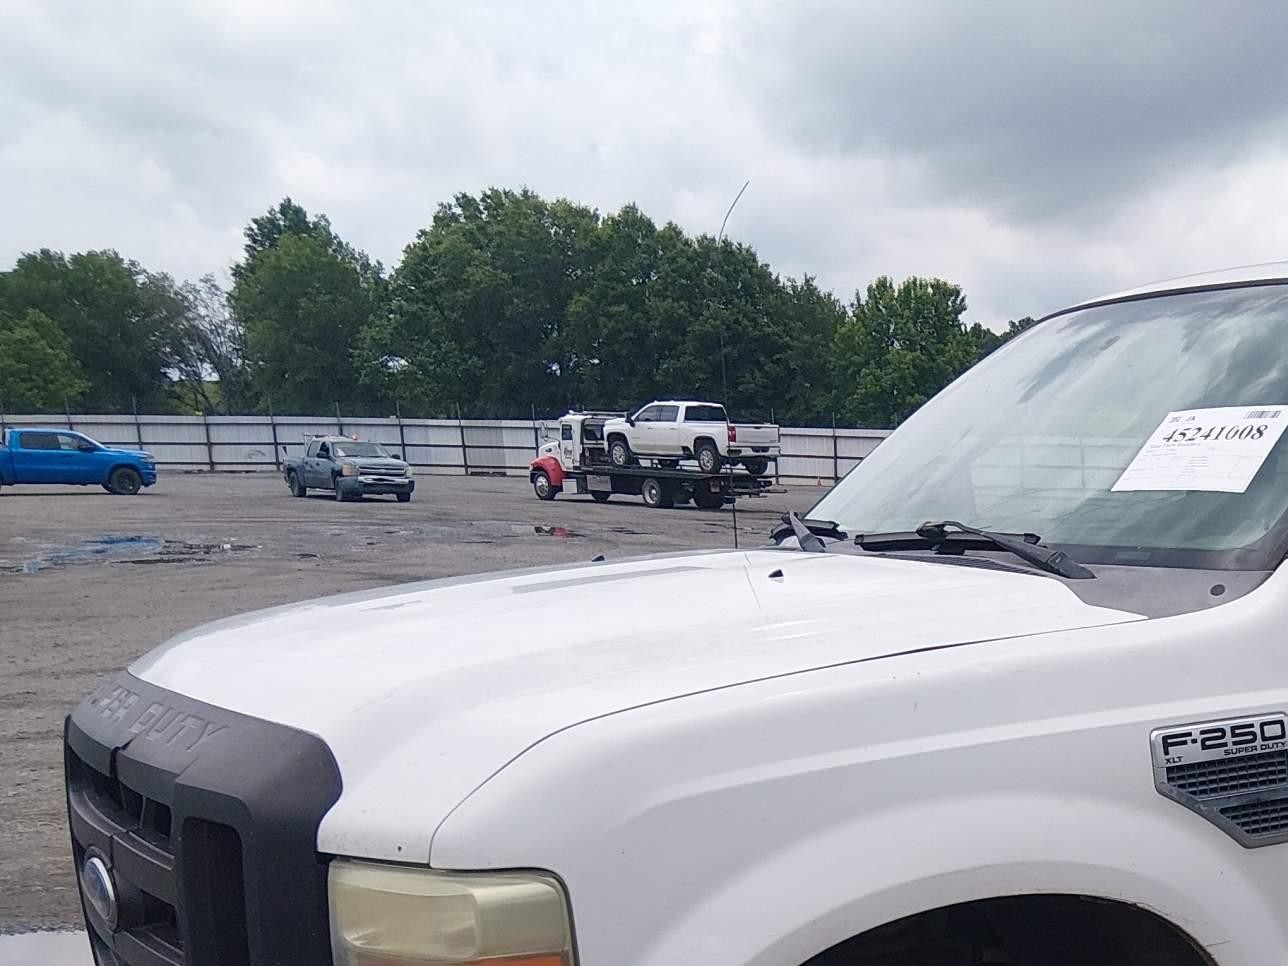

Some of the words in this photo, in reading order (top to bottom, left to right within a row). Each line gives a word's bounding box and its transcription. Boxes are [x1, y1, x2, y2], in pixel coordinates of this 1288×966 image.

[1161, 424, 1269, 443] 45241008
[128, 702, 230, 752] DUTY
[1161, 719, 1287, 755] F-250
[1223, 745, 1258, 757] SUPER
[1260, 740, 1287, 752] DUTY
[1164, 755, 1184, 765] XLT
